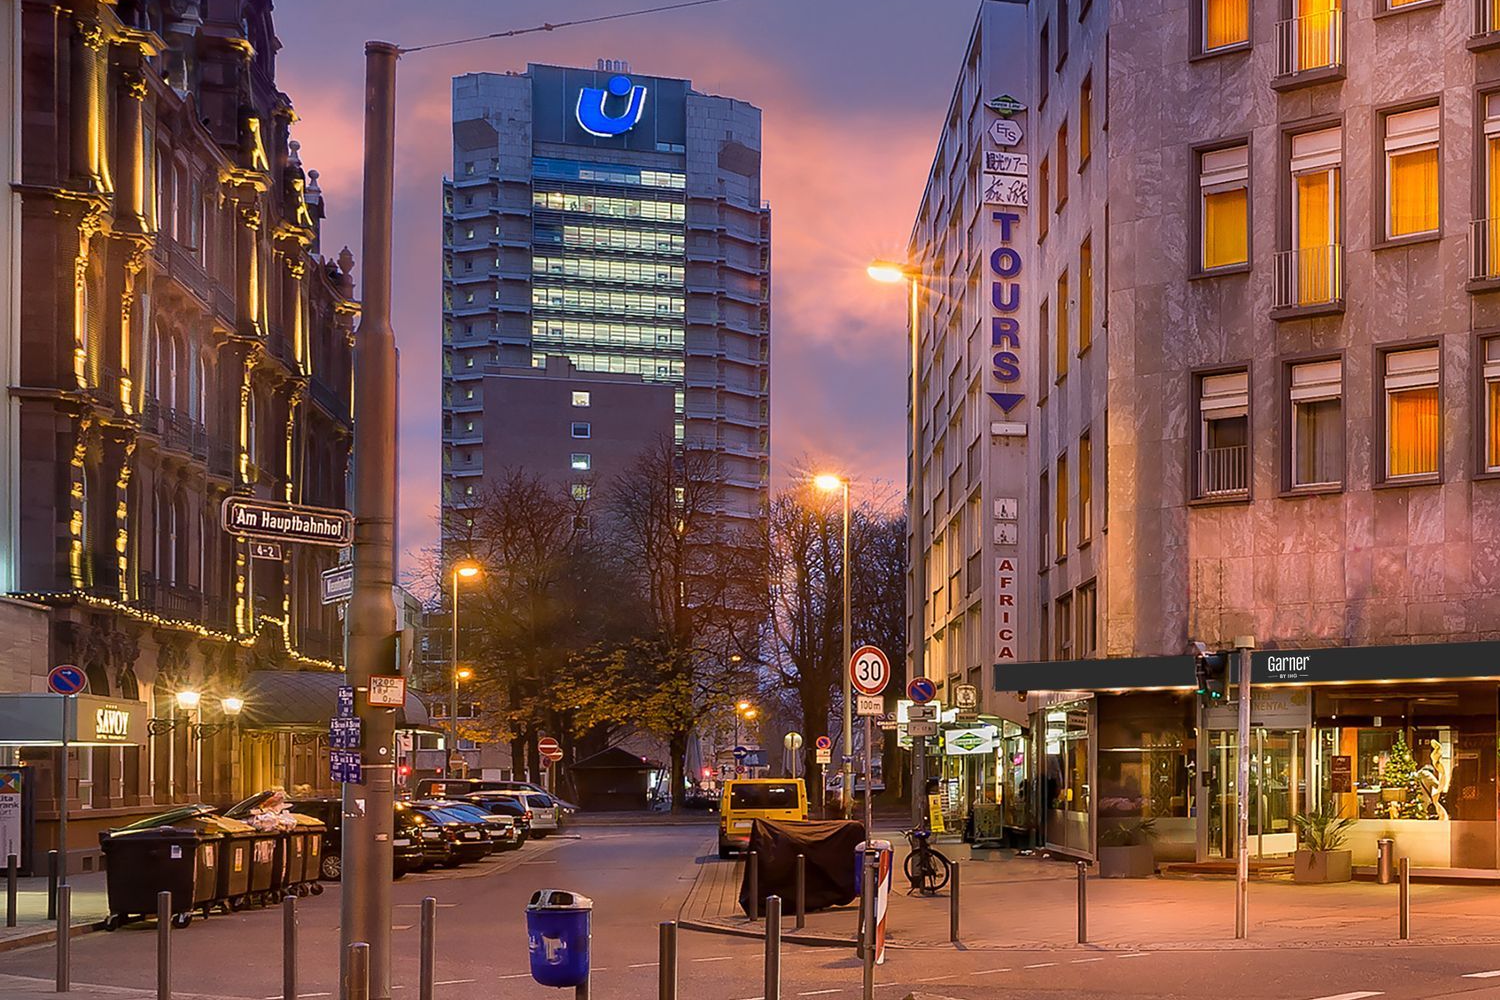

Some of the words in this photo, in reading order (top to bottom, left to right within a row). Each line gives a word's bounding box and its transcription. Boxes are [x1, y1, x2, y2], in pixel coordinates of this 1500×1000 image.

[996, 123, 1017, 142] ETS
[990, 211, 1022, 384] TOURS
[236, 508, 257, 526] Am
[261, 511, 342, 536] Hauptbahnhof
[257, 545, 274, 557] 4-2
[998, 559, 1014, 659] AFRICA
[858, 660, 881, 681] 30
[1267, 655, 1310, 672] Garner
[860, 700, 873, 710] 100
[96, 709, 129, 735] SAVOY
